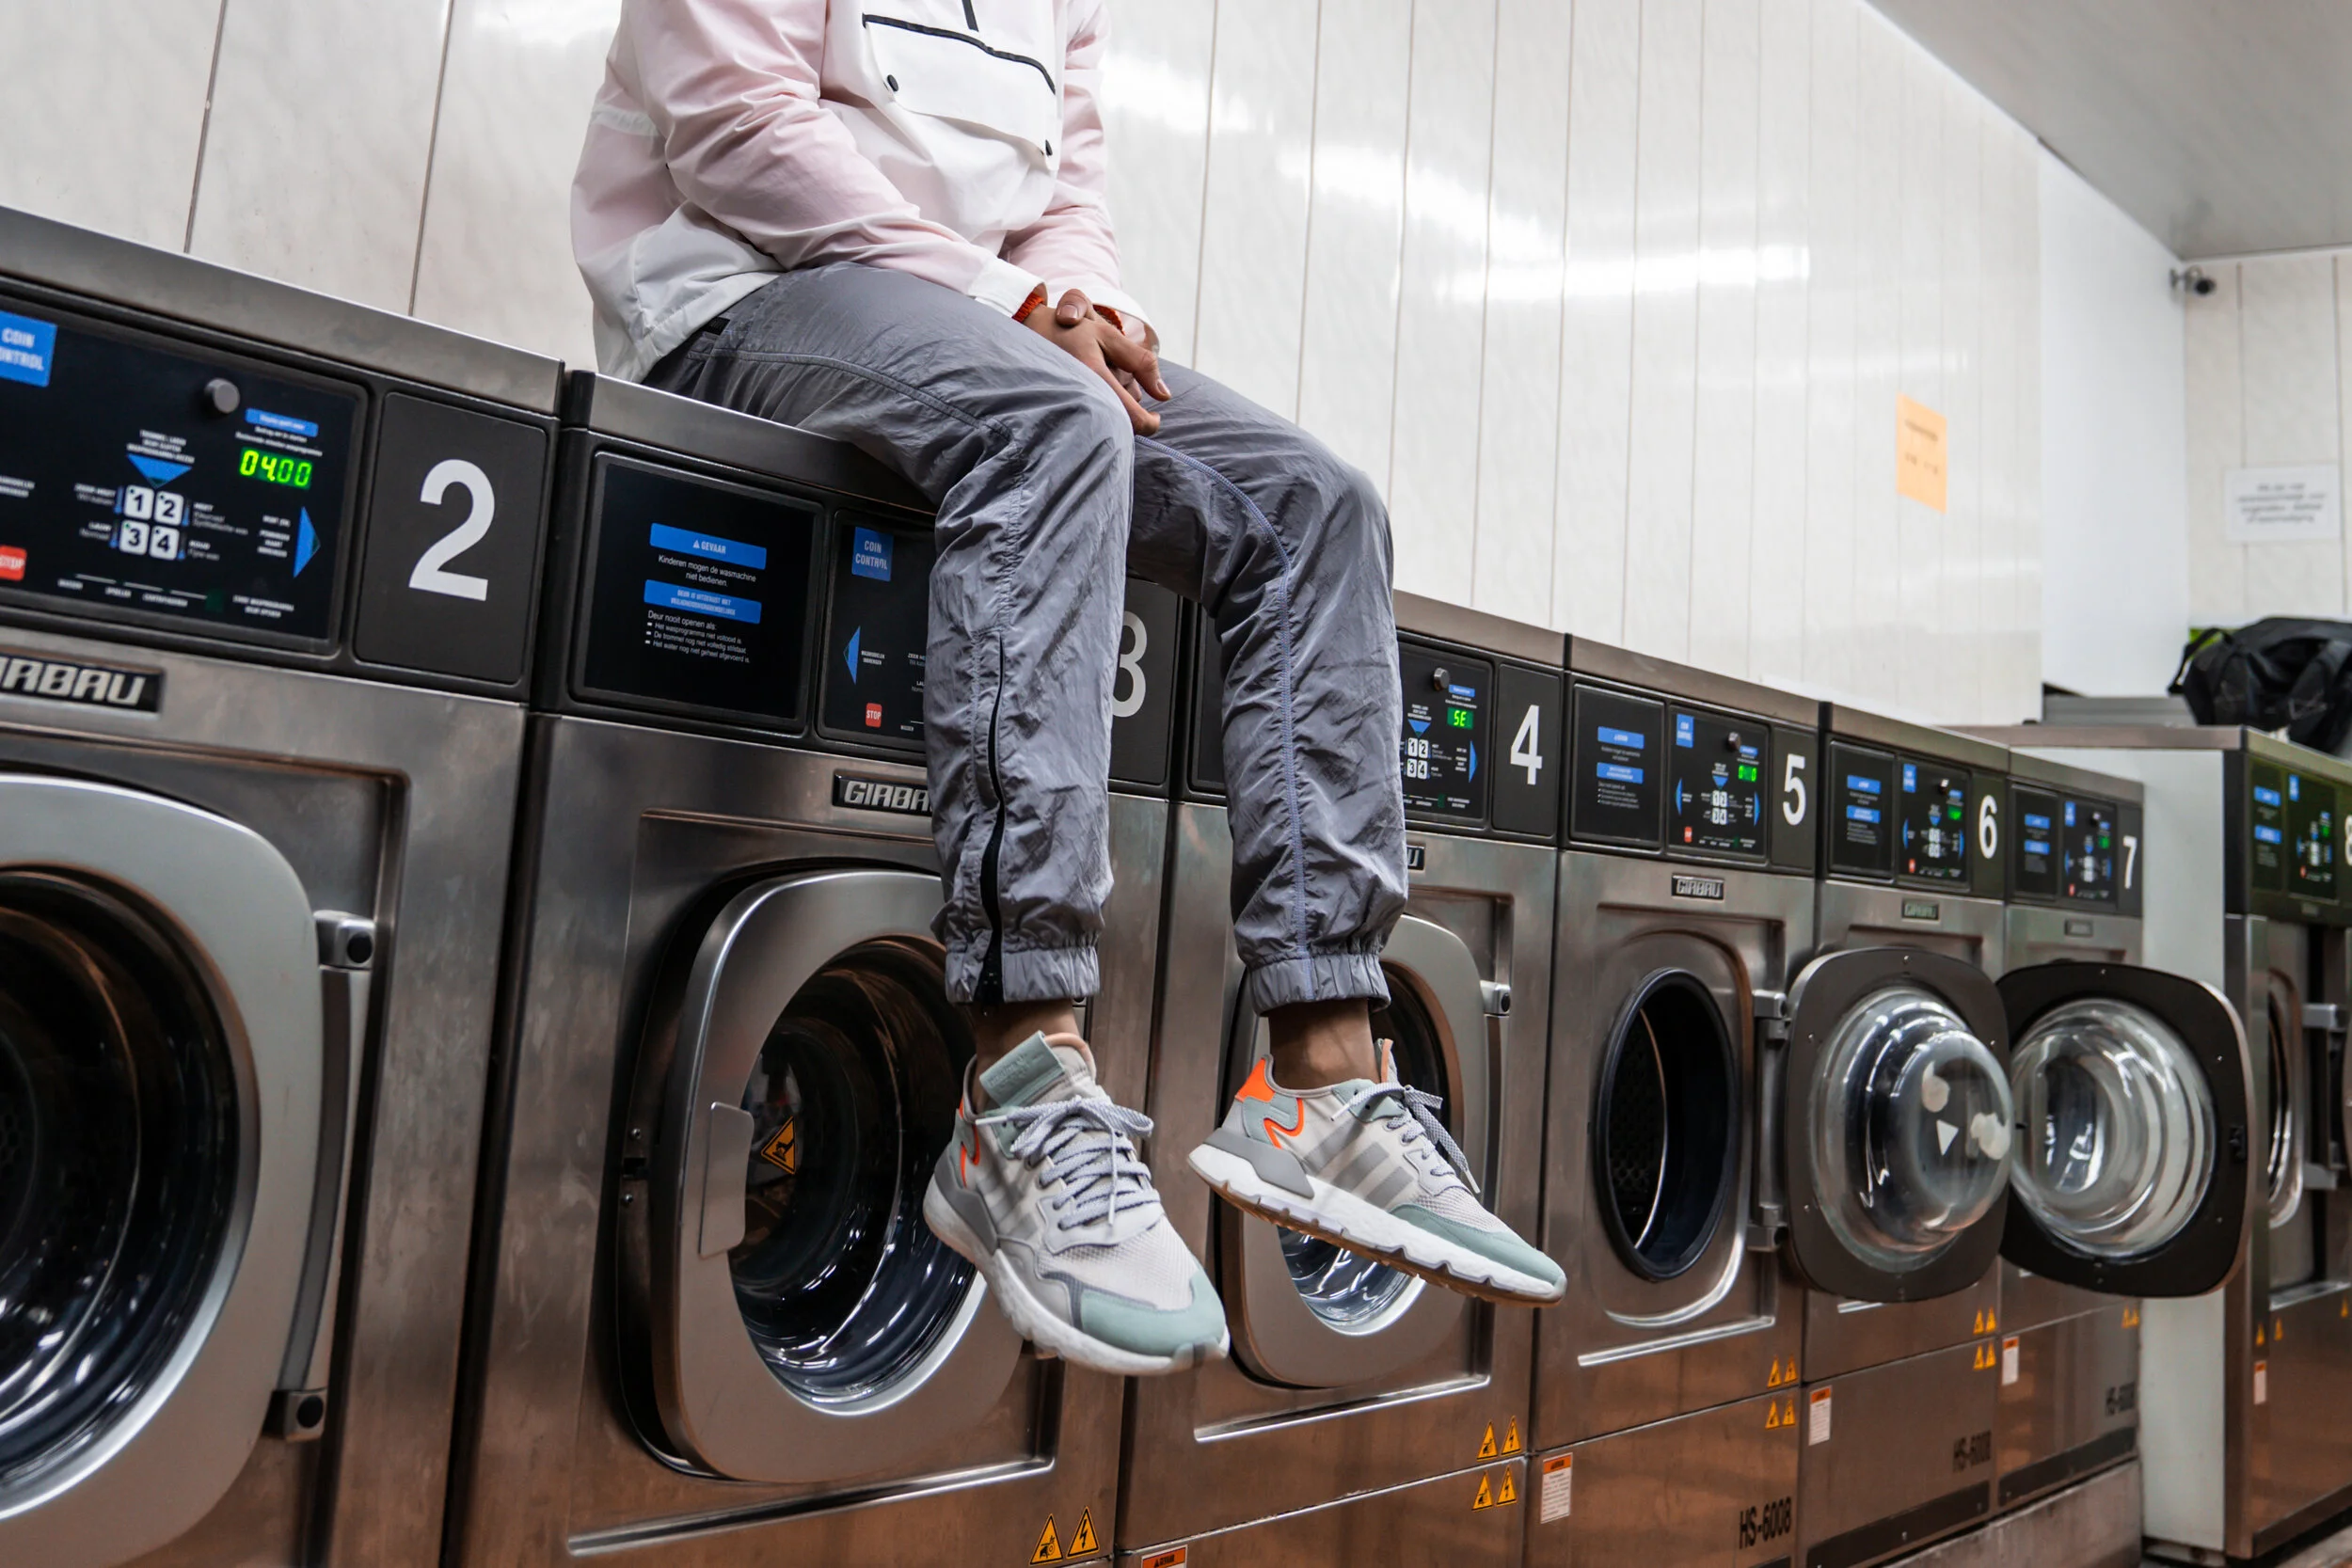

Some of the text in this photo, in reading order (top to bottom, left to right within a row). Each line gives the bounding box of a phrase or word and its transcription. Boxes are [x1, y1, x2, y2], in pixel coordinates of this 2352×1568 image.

[2, 326, 35, 348] COIN
[0, 345, 44, 372] ONTROL
[163, 499, 175, 516] 2
[129, 528, 170, 552] 3 4
[408, 459, 495, 601] 2
[701, 541, 726, 554] GEVAAR
[864, 540, 882, 554] COIN
[659, 554, 756, 582] Kinderen mogen de wasmachine
[855, 552, 888, 571] CONTROL
[686, 572, 697, 581] niet
[648, 610, 664, 620] Deur
[681, 617, 705, 628] openen
[1111, 610, 1148, 718] 3
[866, 709, 882, 721] STOP
[1510, 704, 1543, 785] 4
[844, 780, 933, 812] GIRBA
[1782, 753, 1806, 826] 5
[1978, 795, 1998, 859] 6
[2122, 835, 2137, 889] 7
[1676, 879, 1722, 897] GIRBAU
[1739, 1496, 1791, 1550] HS-6008
